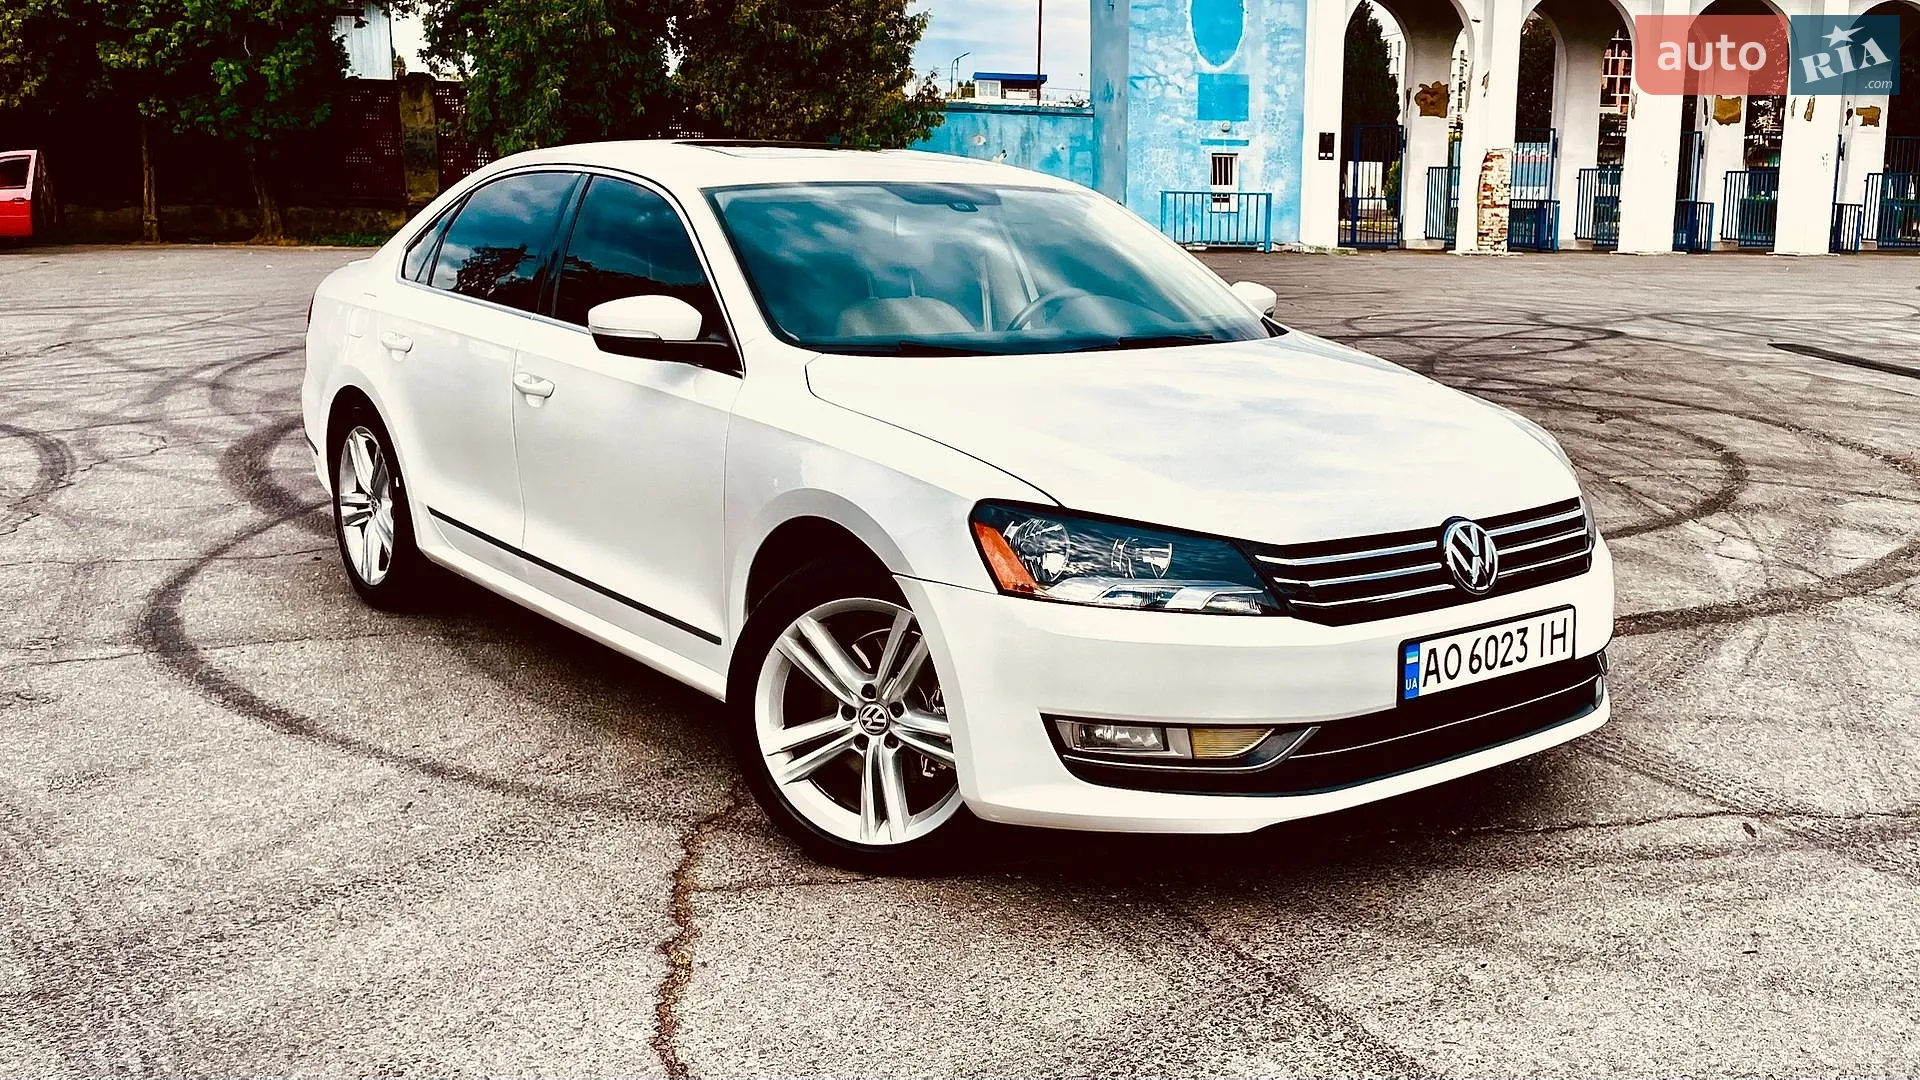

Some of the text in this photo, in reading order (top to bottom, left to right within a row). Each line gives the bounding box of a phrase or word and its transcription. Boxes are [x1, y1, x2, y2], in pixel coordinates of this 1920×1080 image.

[1422, 617, 1568, 688] AO 6023 IH
[1405, 677, 1418, 691] UA
